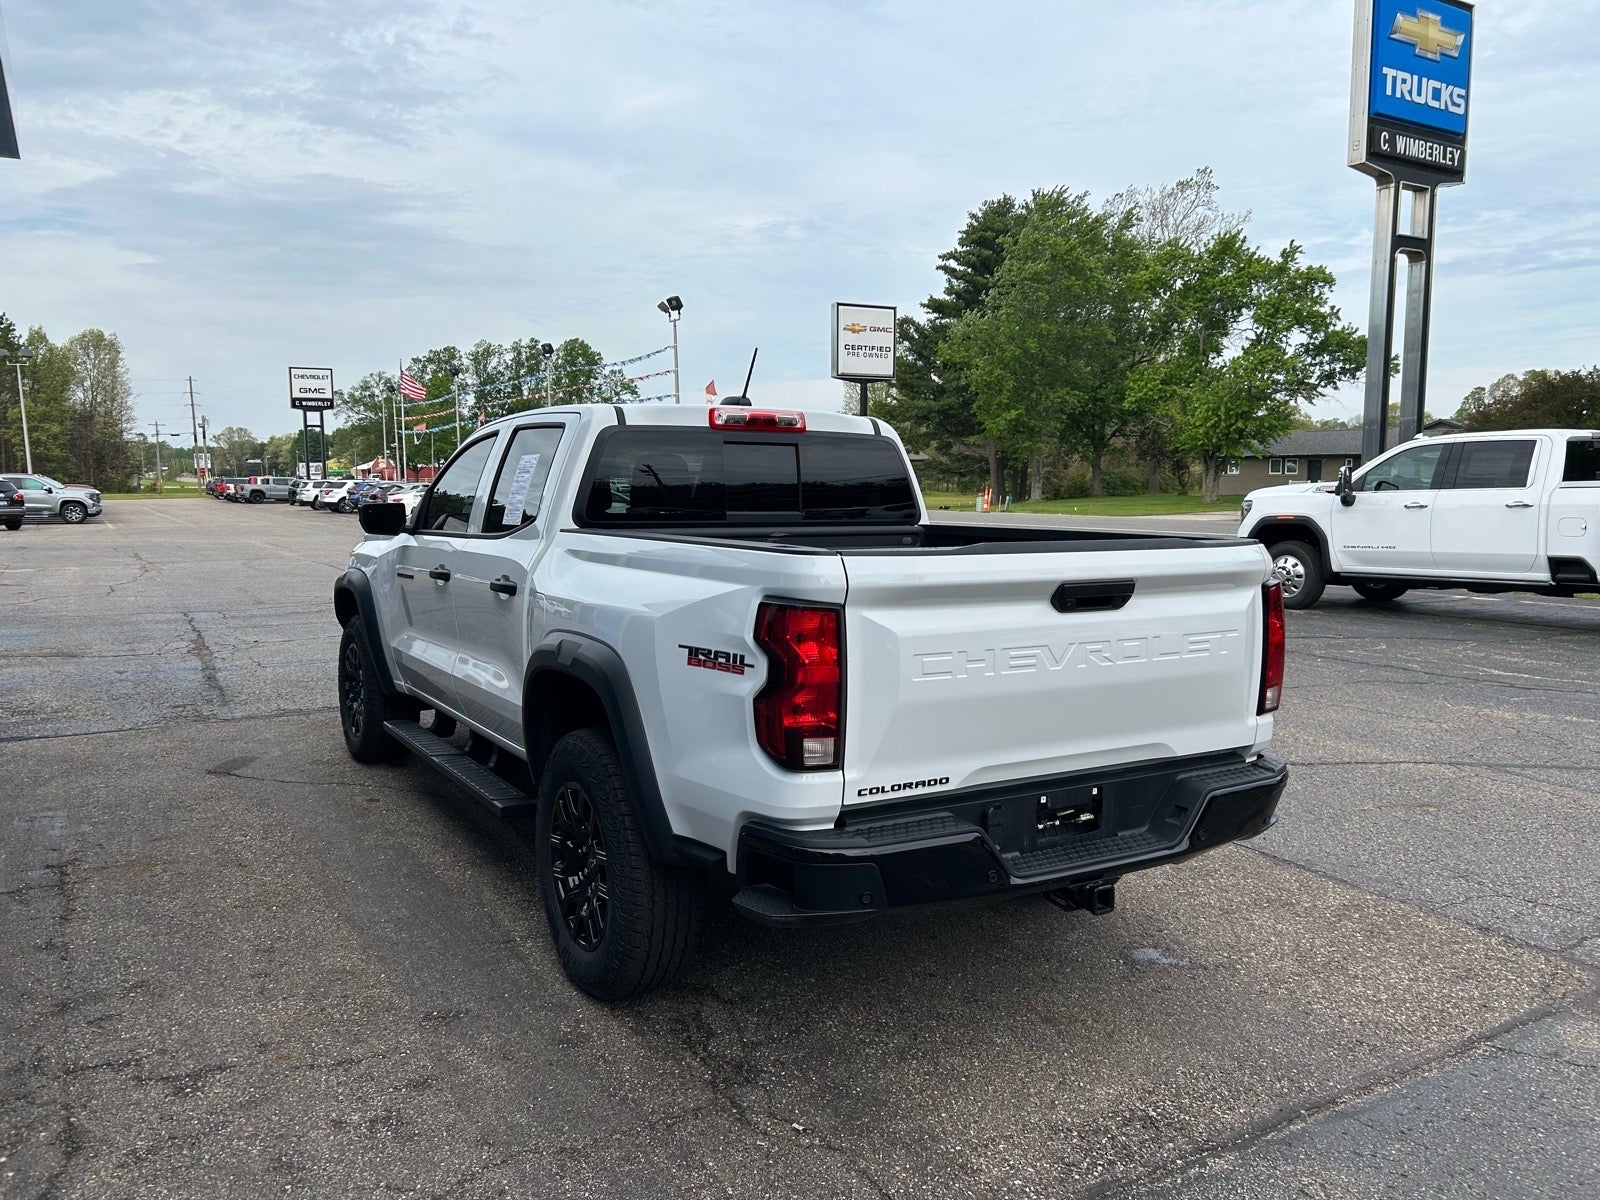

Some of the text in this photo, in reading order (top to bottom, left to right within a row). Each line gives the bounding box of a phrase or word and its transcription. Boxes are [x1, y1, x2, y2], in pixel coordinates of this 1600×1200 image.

[1382, 66, 1466, 115] TRUCKS
[1380, 131, 1460, 167] C. WIMBERLEY
[844, 344, 891, 353] CERTIFIED
[847, 351, 888, 359] PRE-OWNED
[678, 644, 755, 668] TRAIL
[687, 656, 745, 675] BOSS
[912, 629, 1239, 681] CHEVROLET
[857, 776, 950, 797] COLORADO
